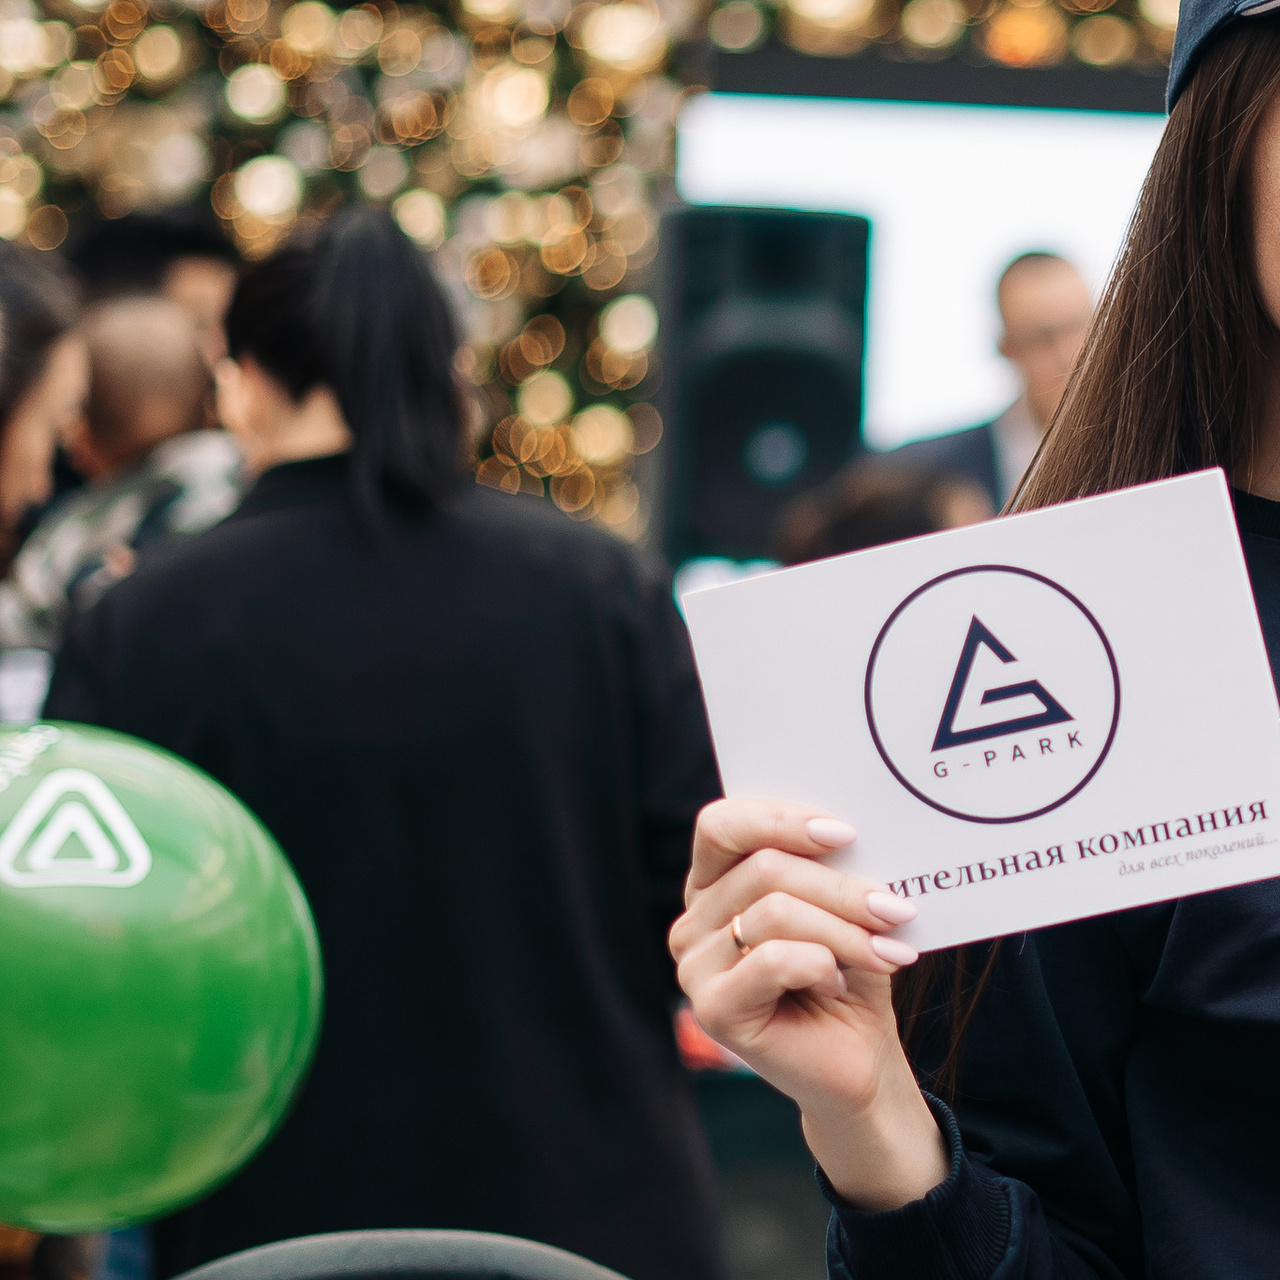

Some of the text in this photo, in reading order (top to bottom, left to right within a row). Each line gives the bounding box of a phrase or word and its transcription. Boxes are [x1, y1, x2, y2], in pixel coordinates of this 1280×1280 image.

[933, 730, 1084, 778] G-PARK
[886, 799, 1269, 899] ительная компания
